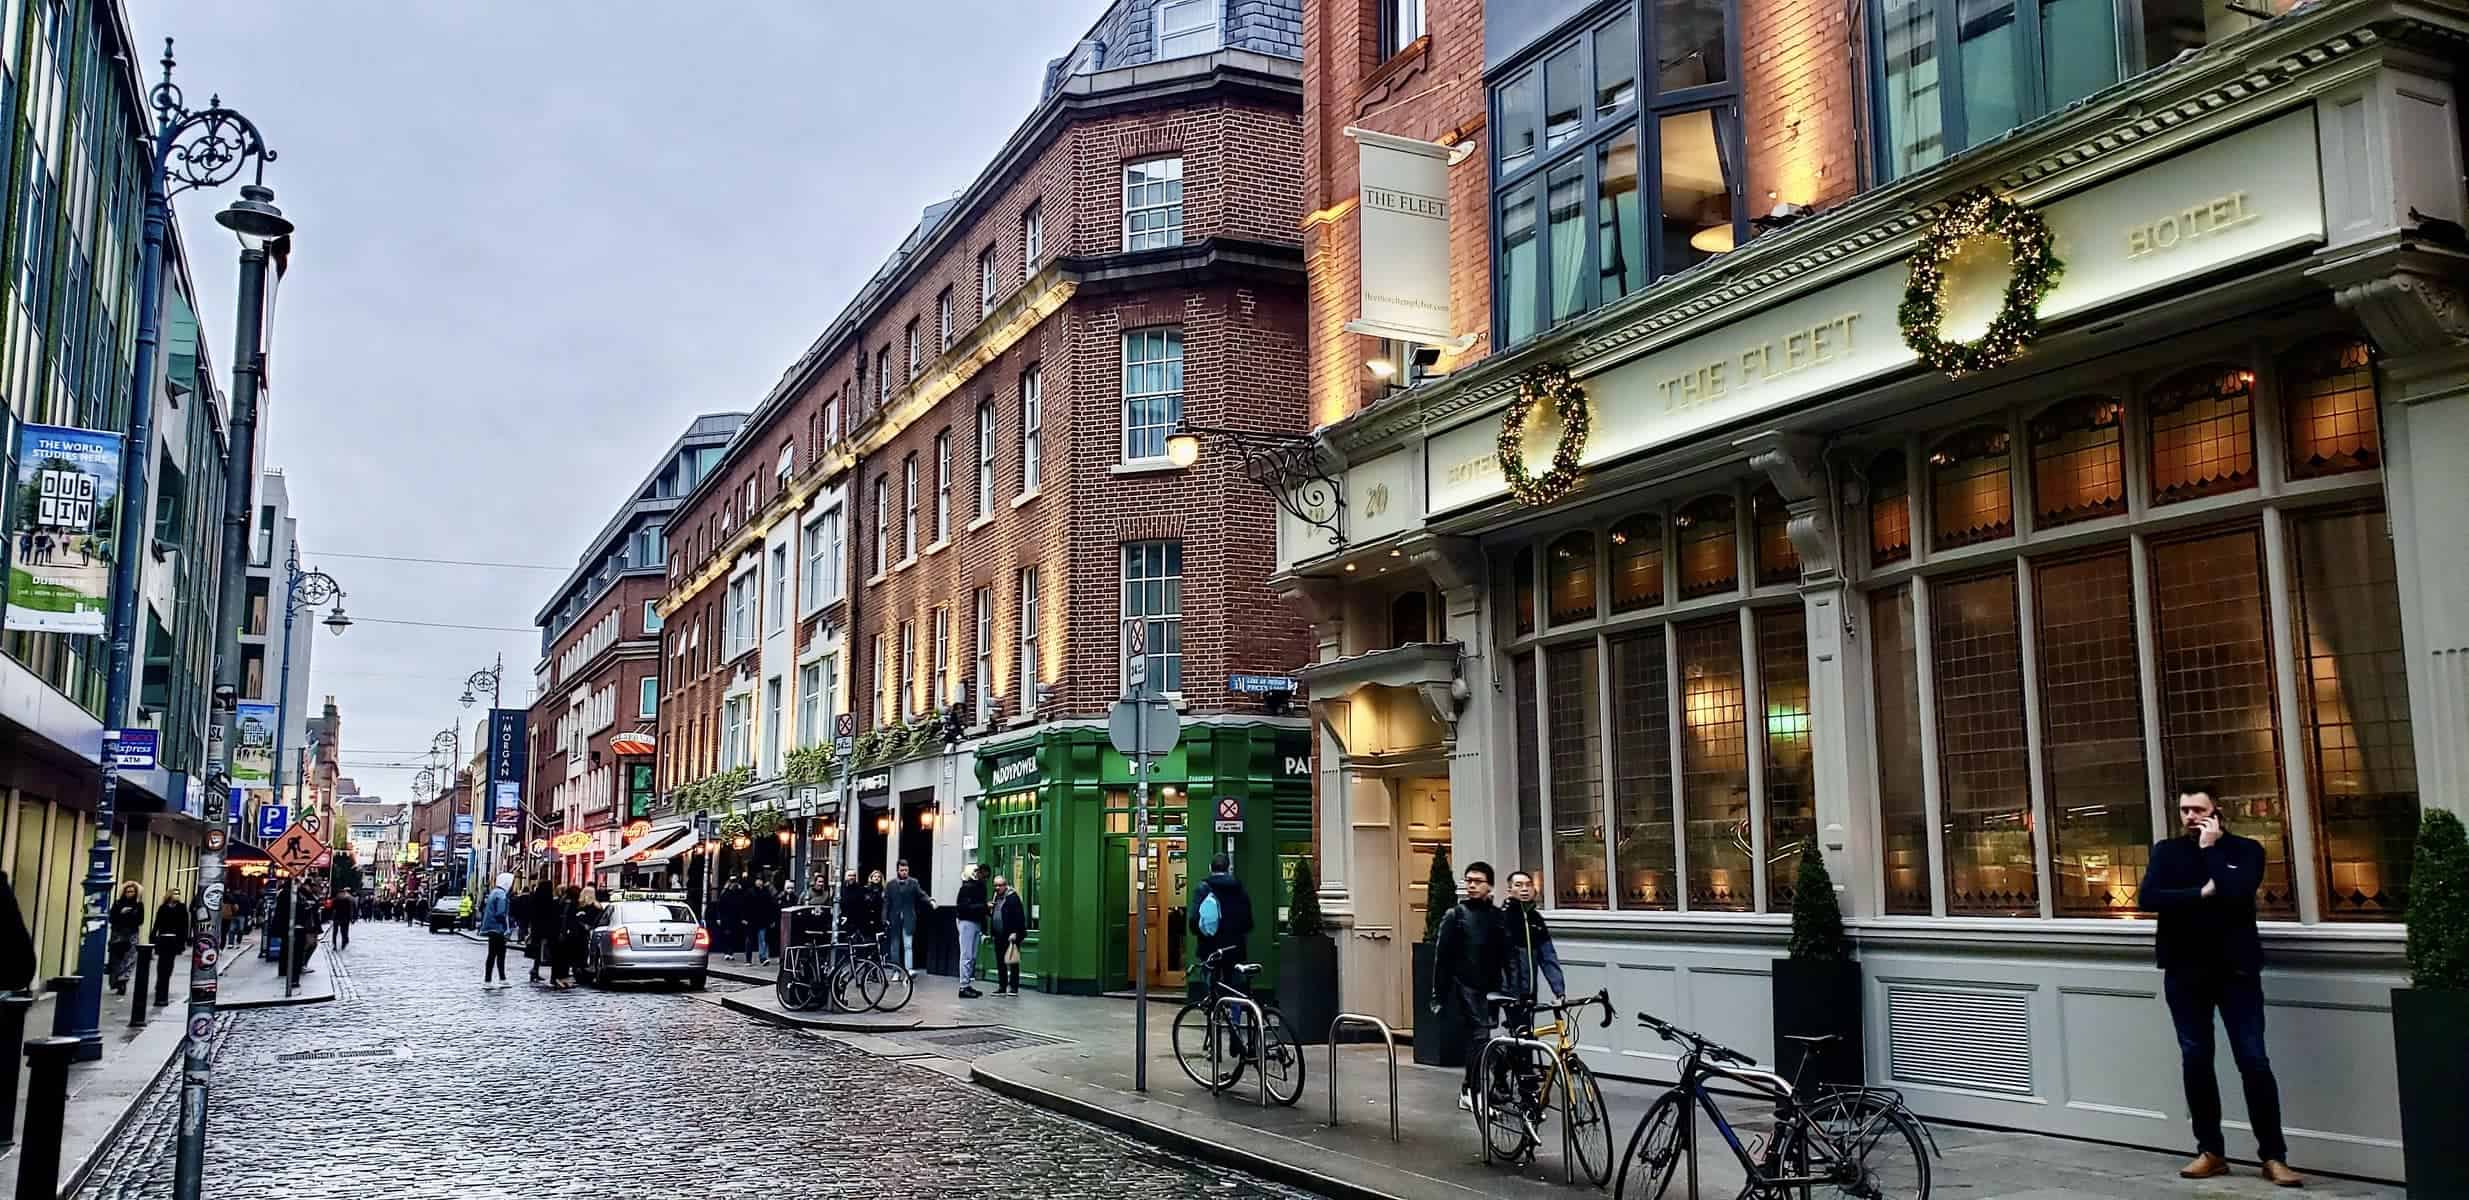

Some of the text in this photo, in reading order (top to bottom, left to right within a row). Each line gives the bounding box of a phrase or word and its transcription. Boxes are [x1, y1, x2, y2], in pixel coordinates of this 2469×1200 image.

[1366, 190, 1447, 217] THE FLEET
[2127, 190, 2258, 259] HOTEL
[1656, 312, 1861, 415] THE FLEET
[39, 439, 103, 453] THE WORLD
[1366, 481, 1390, 518] 20
[1285, 756, 1313, 775] PA
[267, 808, 281, 824] P
